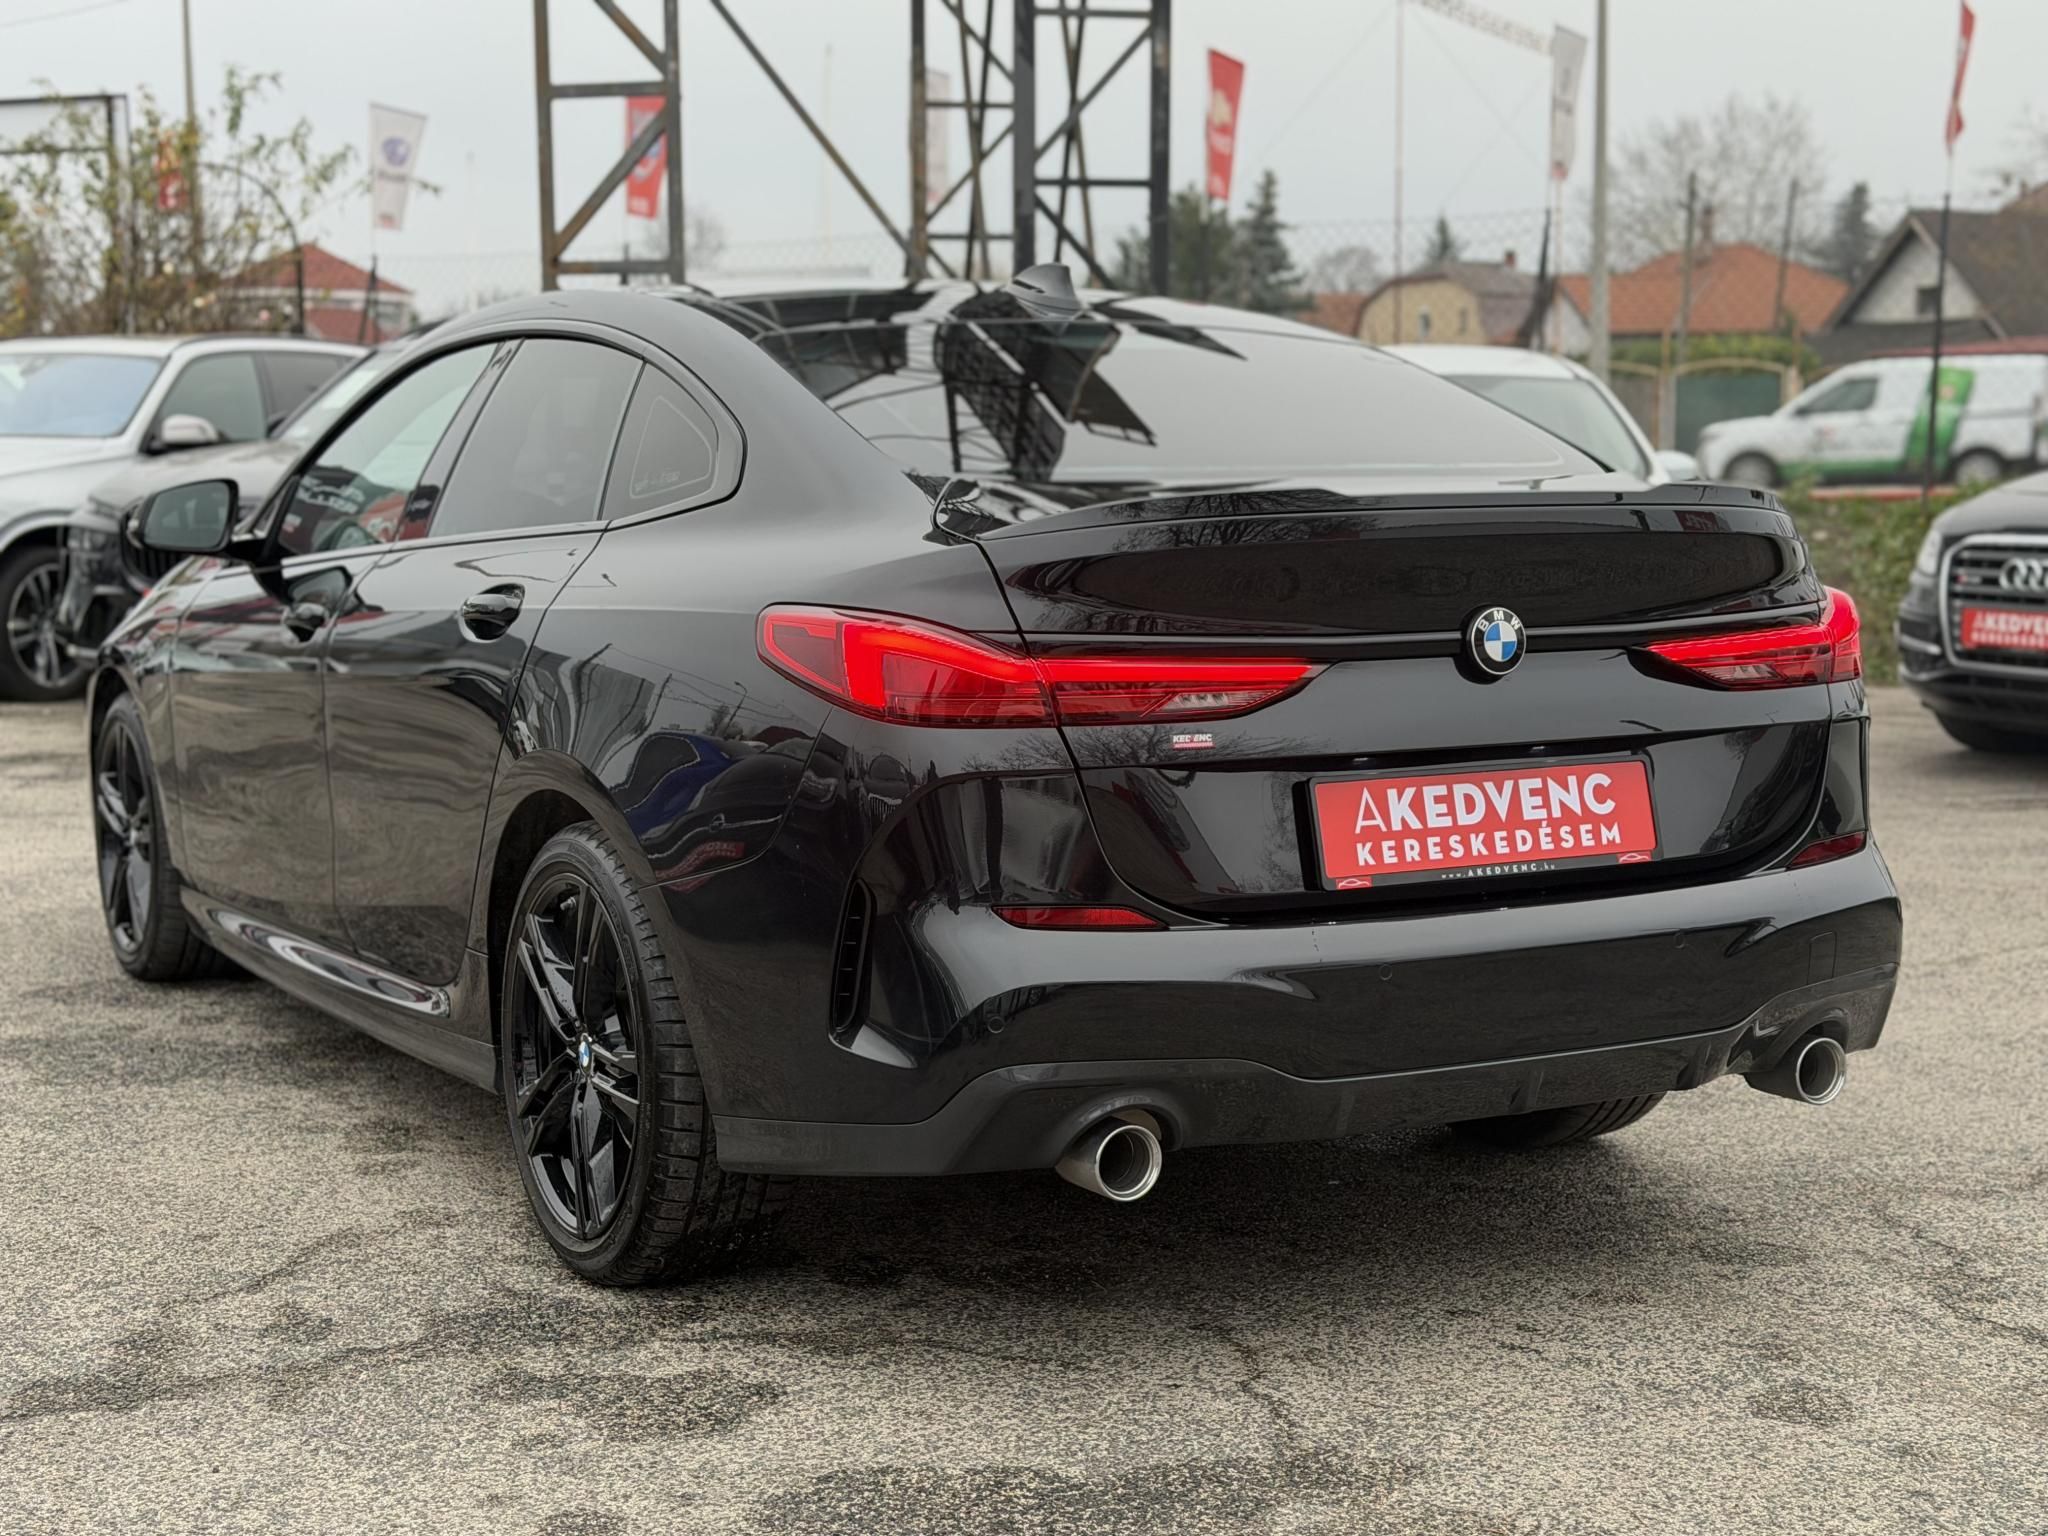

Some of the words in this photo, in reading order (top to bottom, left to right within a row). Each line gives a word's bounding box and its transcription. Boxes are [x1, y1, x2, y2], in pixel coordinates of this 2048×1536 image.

[1478, 610, 1521, 631] BMW
[1971, 610, 2048, 635] AKEDVE
[1356, 820, 1621, 866] KERESKEDÉSEM
